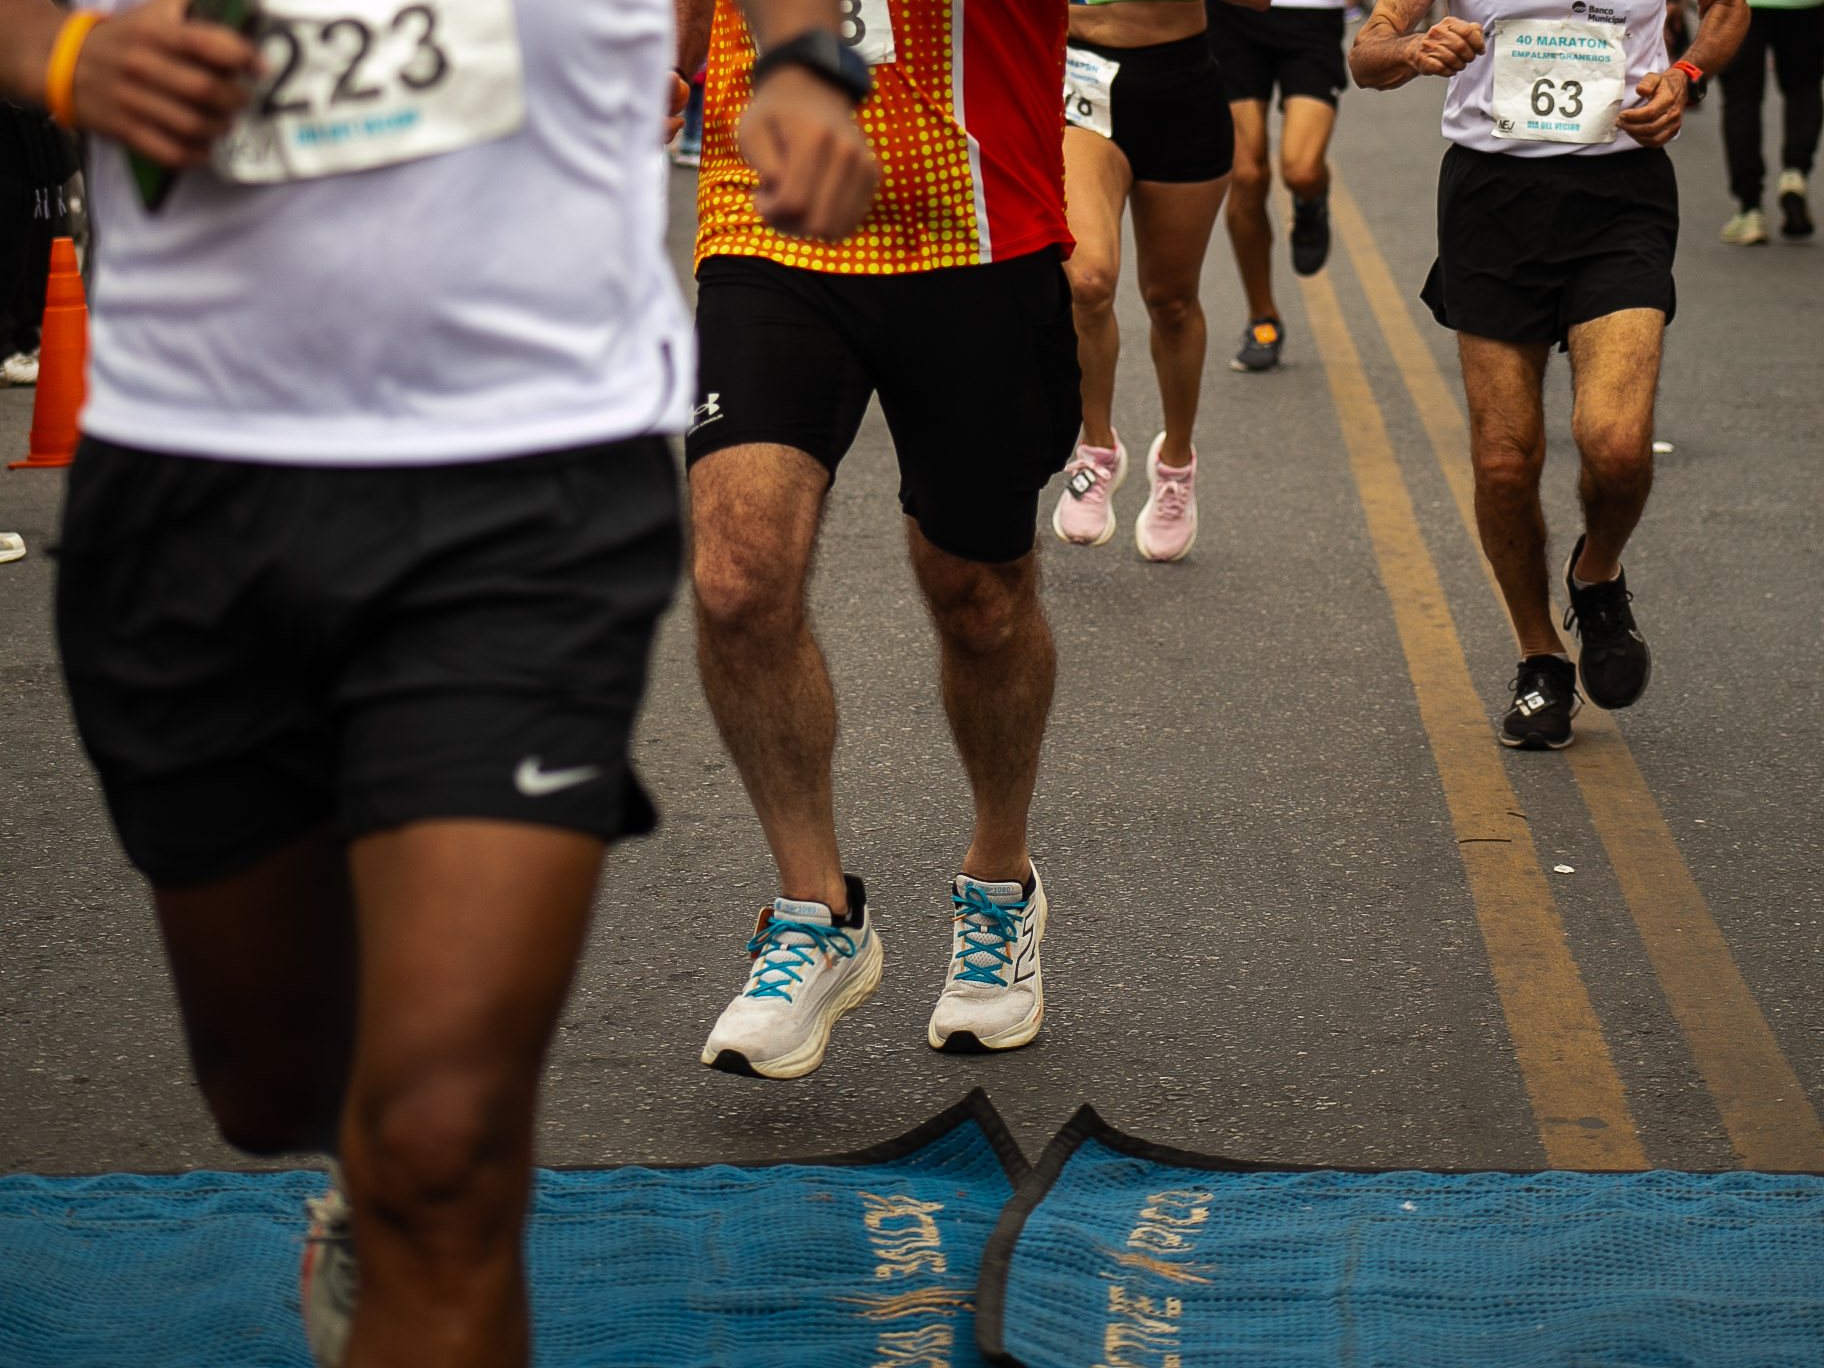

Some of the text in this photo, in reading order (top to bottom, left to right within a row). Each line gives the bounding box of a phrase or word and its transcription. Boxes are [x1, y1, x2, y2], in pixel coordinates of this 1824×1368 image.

[1588, 5, 1614, 15] Banco
[1587, 14, 1627, 25] Municipal
[1516, 34, 1608, 49] 40 MARATON
[258, 2, 452, 116] 223
[1511, 50, 1612, 63] EMPALME GRANEROS
[1530, 78, 1583, 118] 63
